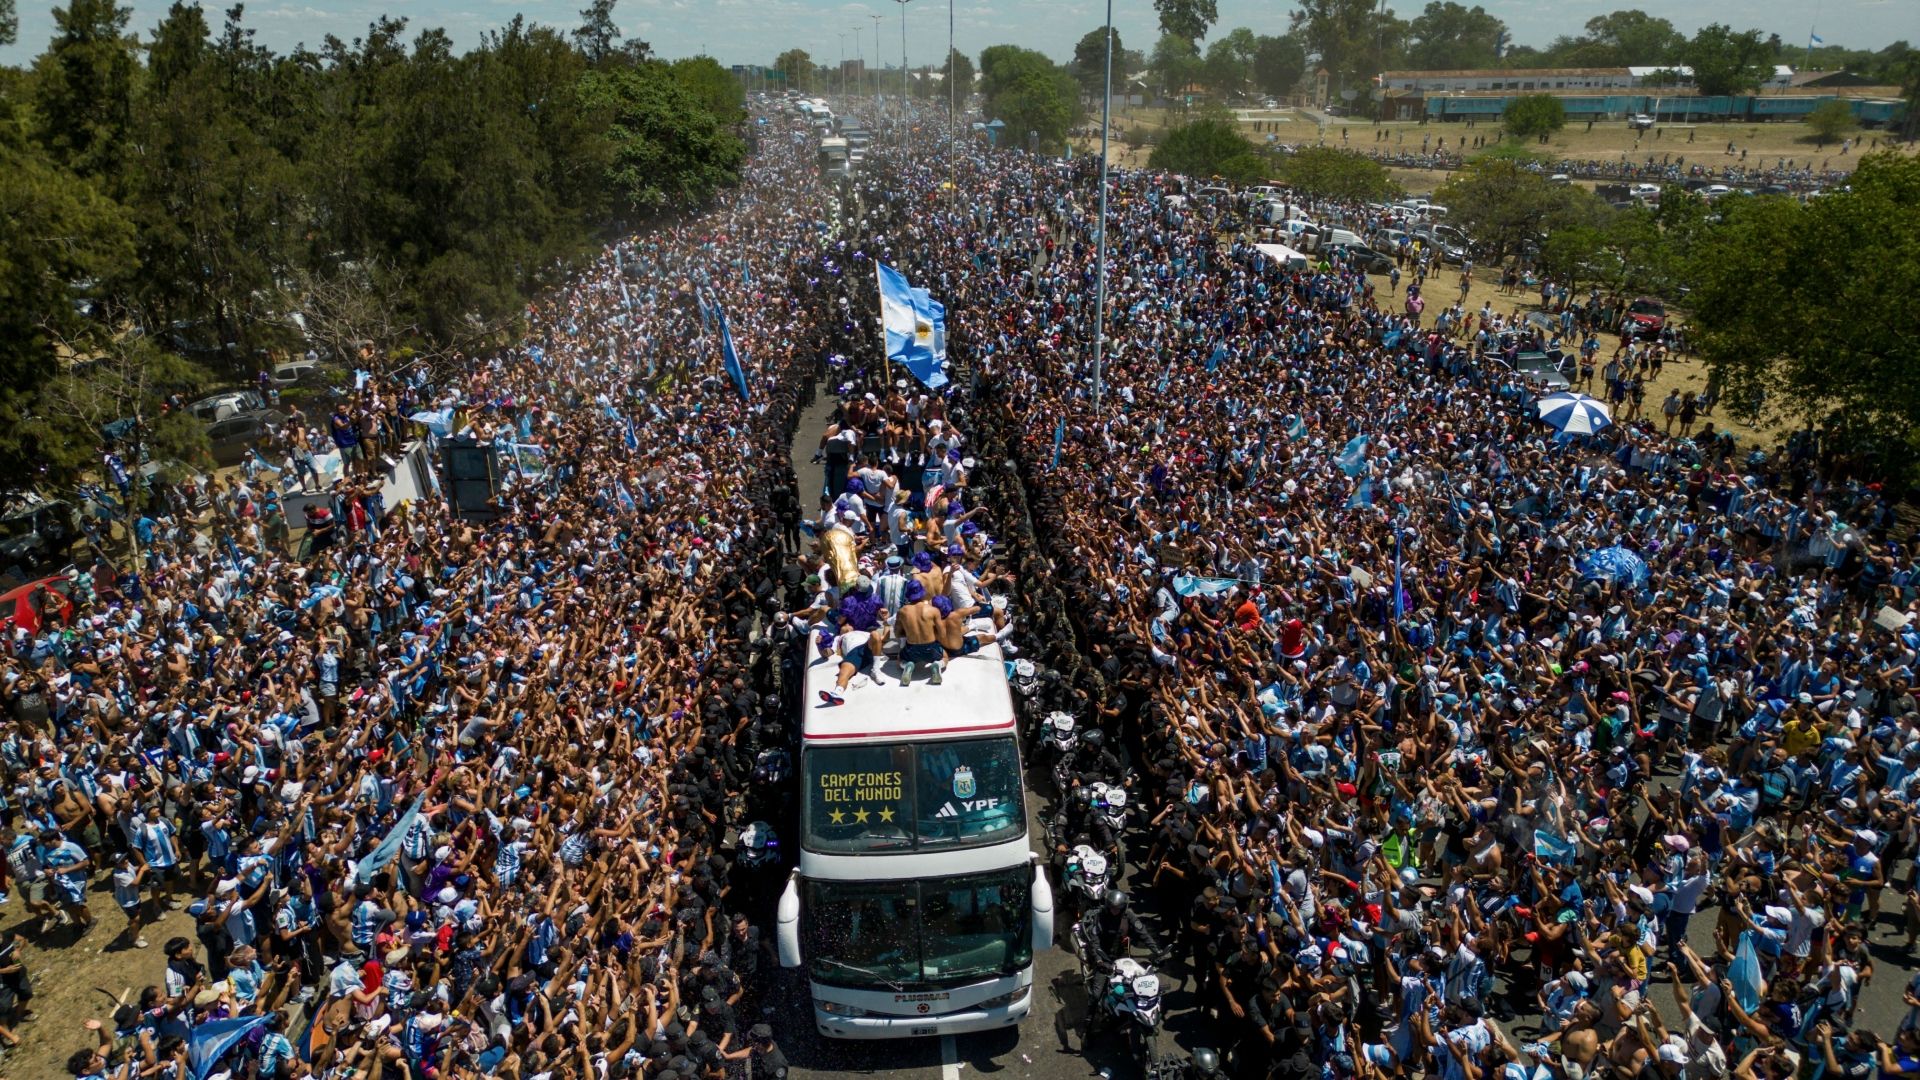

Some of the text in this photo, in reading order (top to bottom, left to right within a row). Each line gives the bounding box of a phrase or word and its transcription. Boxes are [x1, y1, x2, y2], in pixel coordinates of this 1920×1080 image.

[821, 772, 902, 788] CAMPEONES
[824, 786, 902, 802] DEL MUNDO
[961, 798, 998, 812] YPF
[1542, 967, 1551, 975] 10
[895, 993, 949, 1002] PLUSMAR
